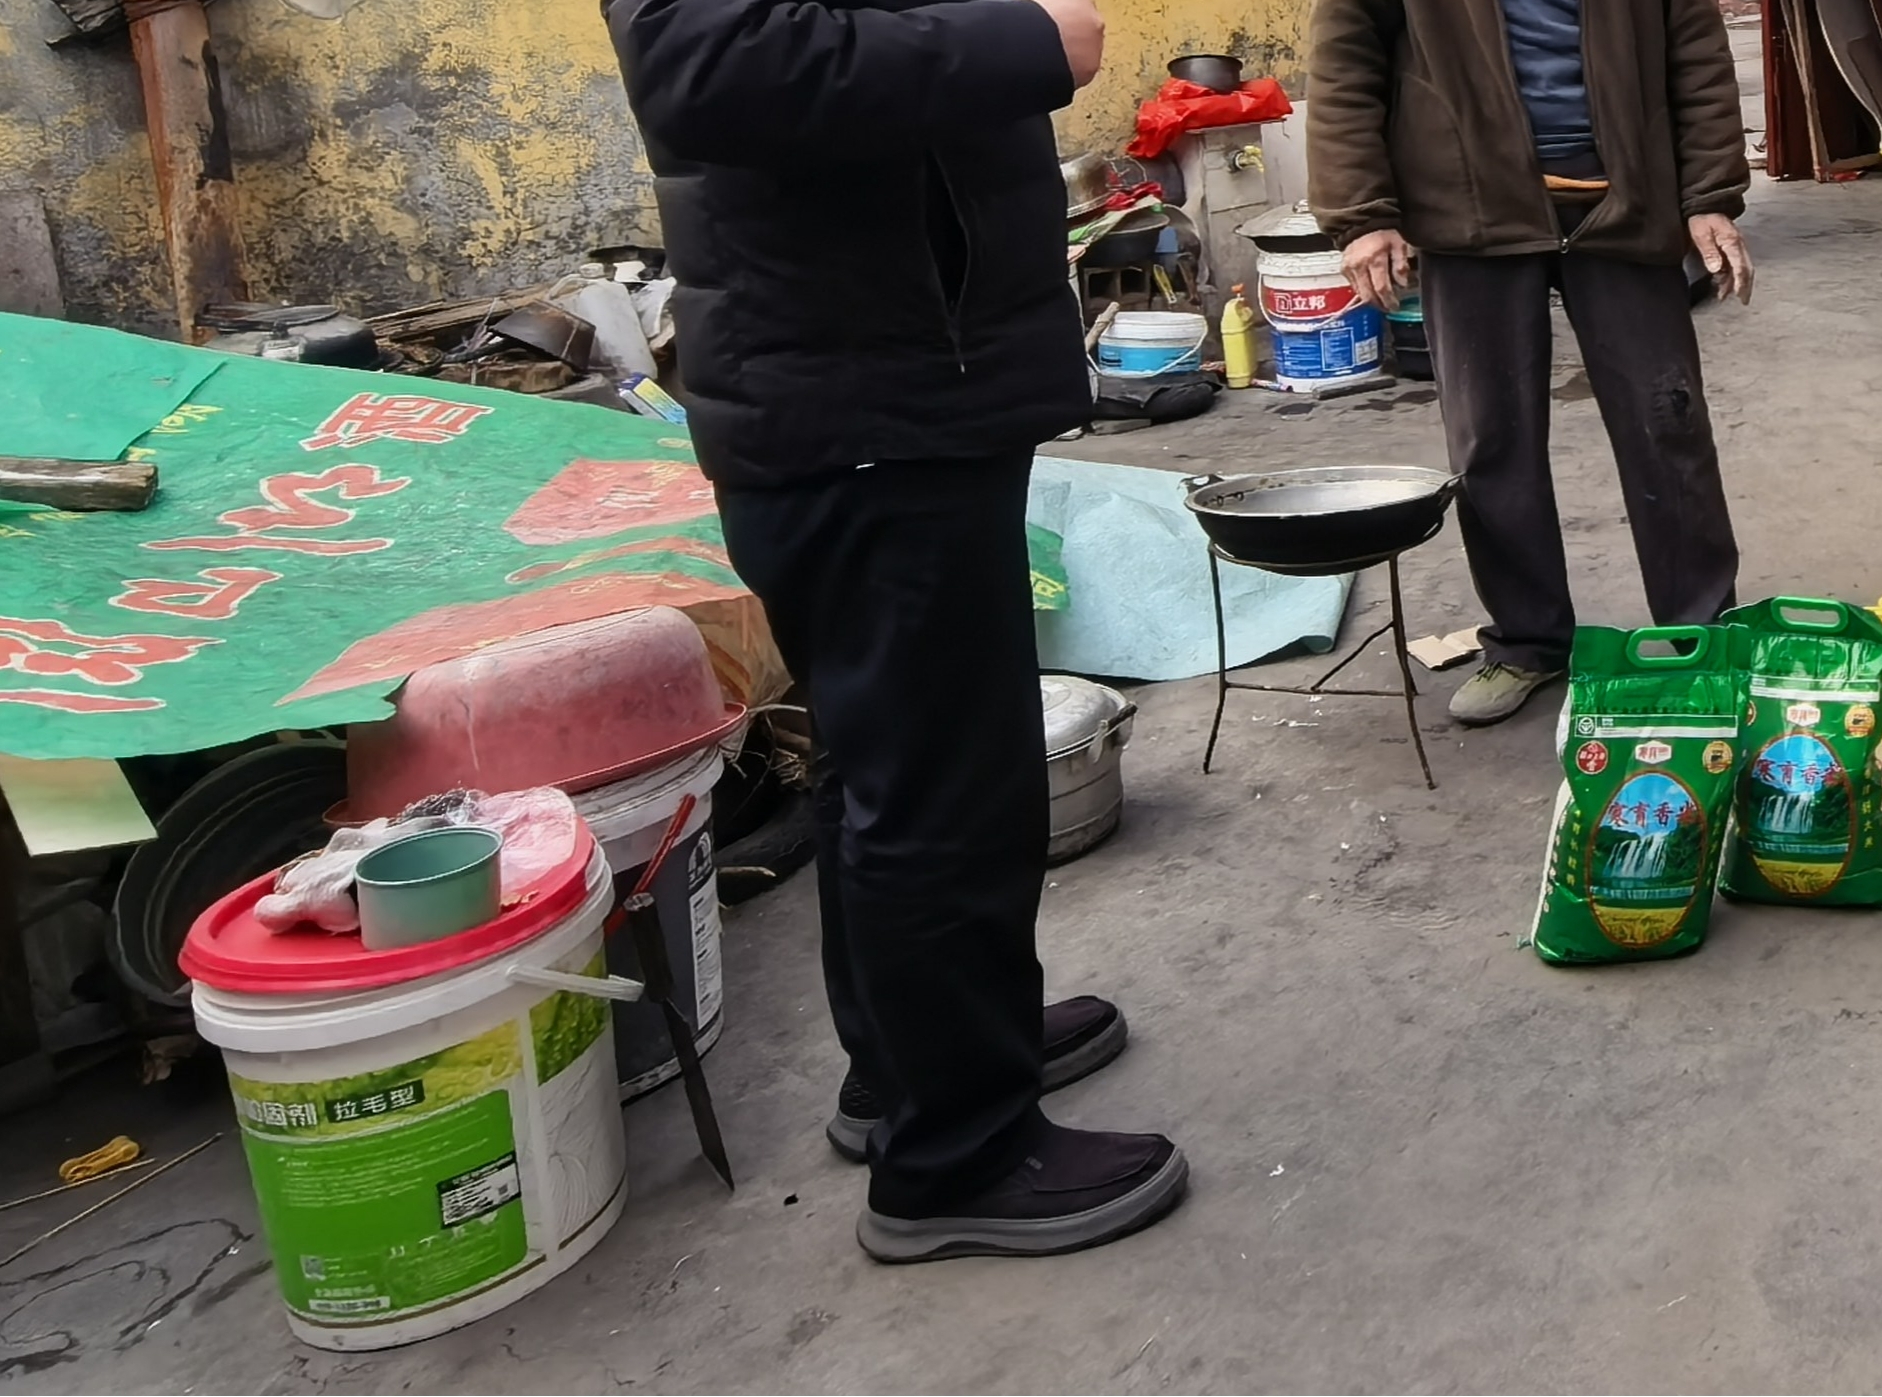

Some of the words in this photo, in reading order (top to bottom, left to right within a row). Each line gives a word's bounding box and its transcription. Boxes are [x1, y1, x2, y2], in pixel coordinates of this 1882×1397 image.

[1292, 294, 1326, 311] 立邦
[333, 1085, 417, 1121] 拉毛型
